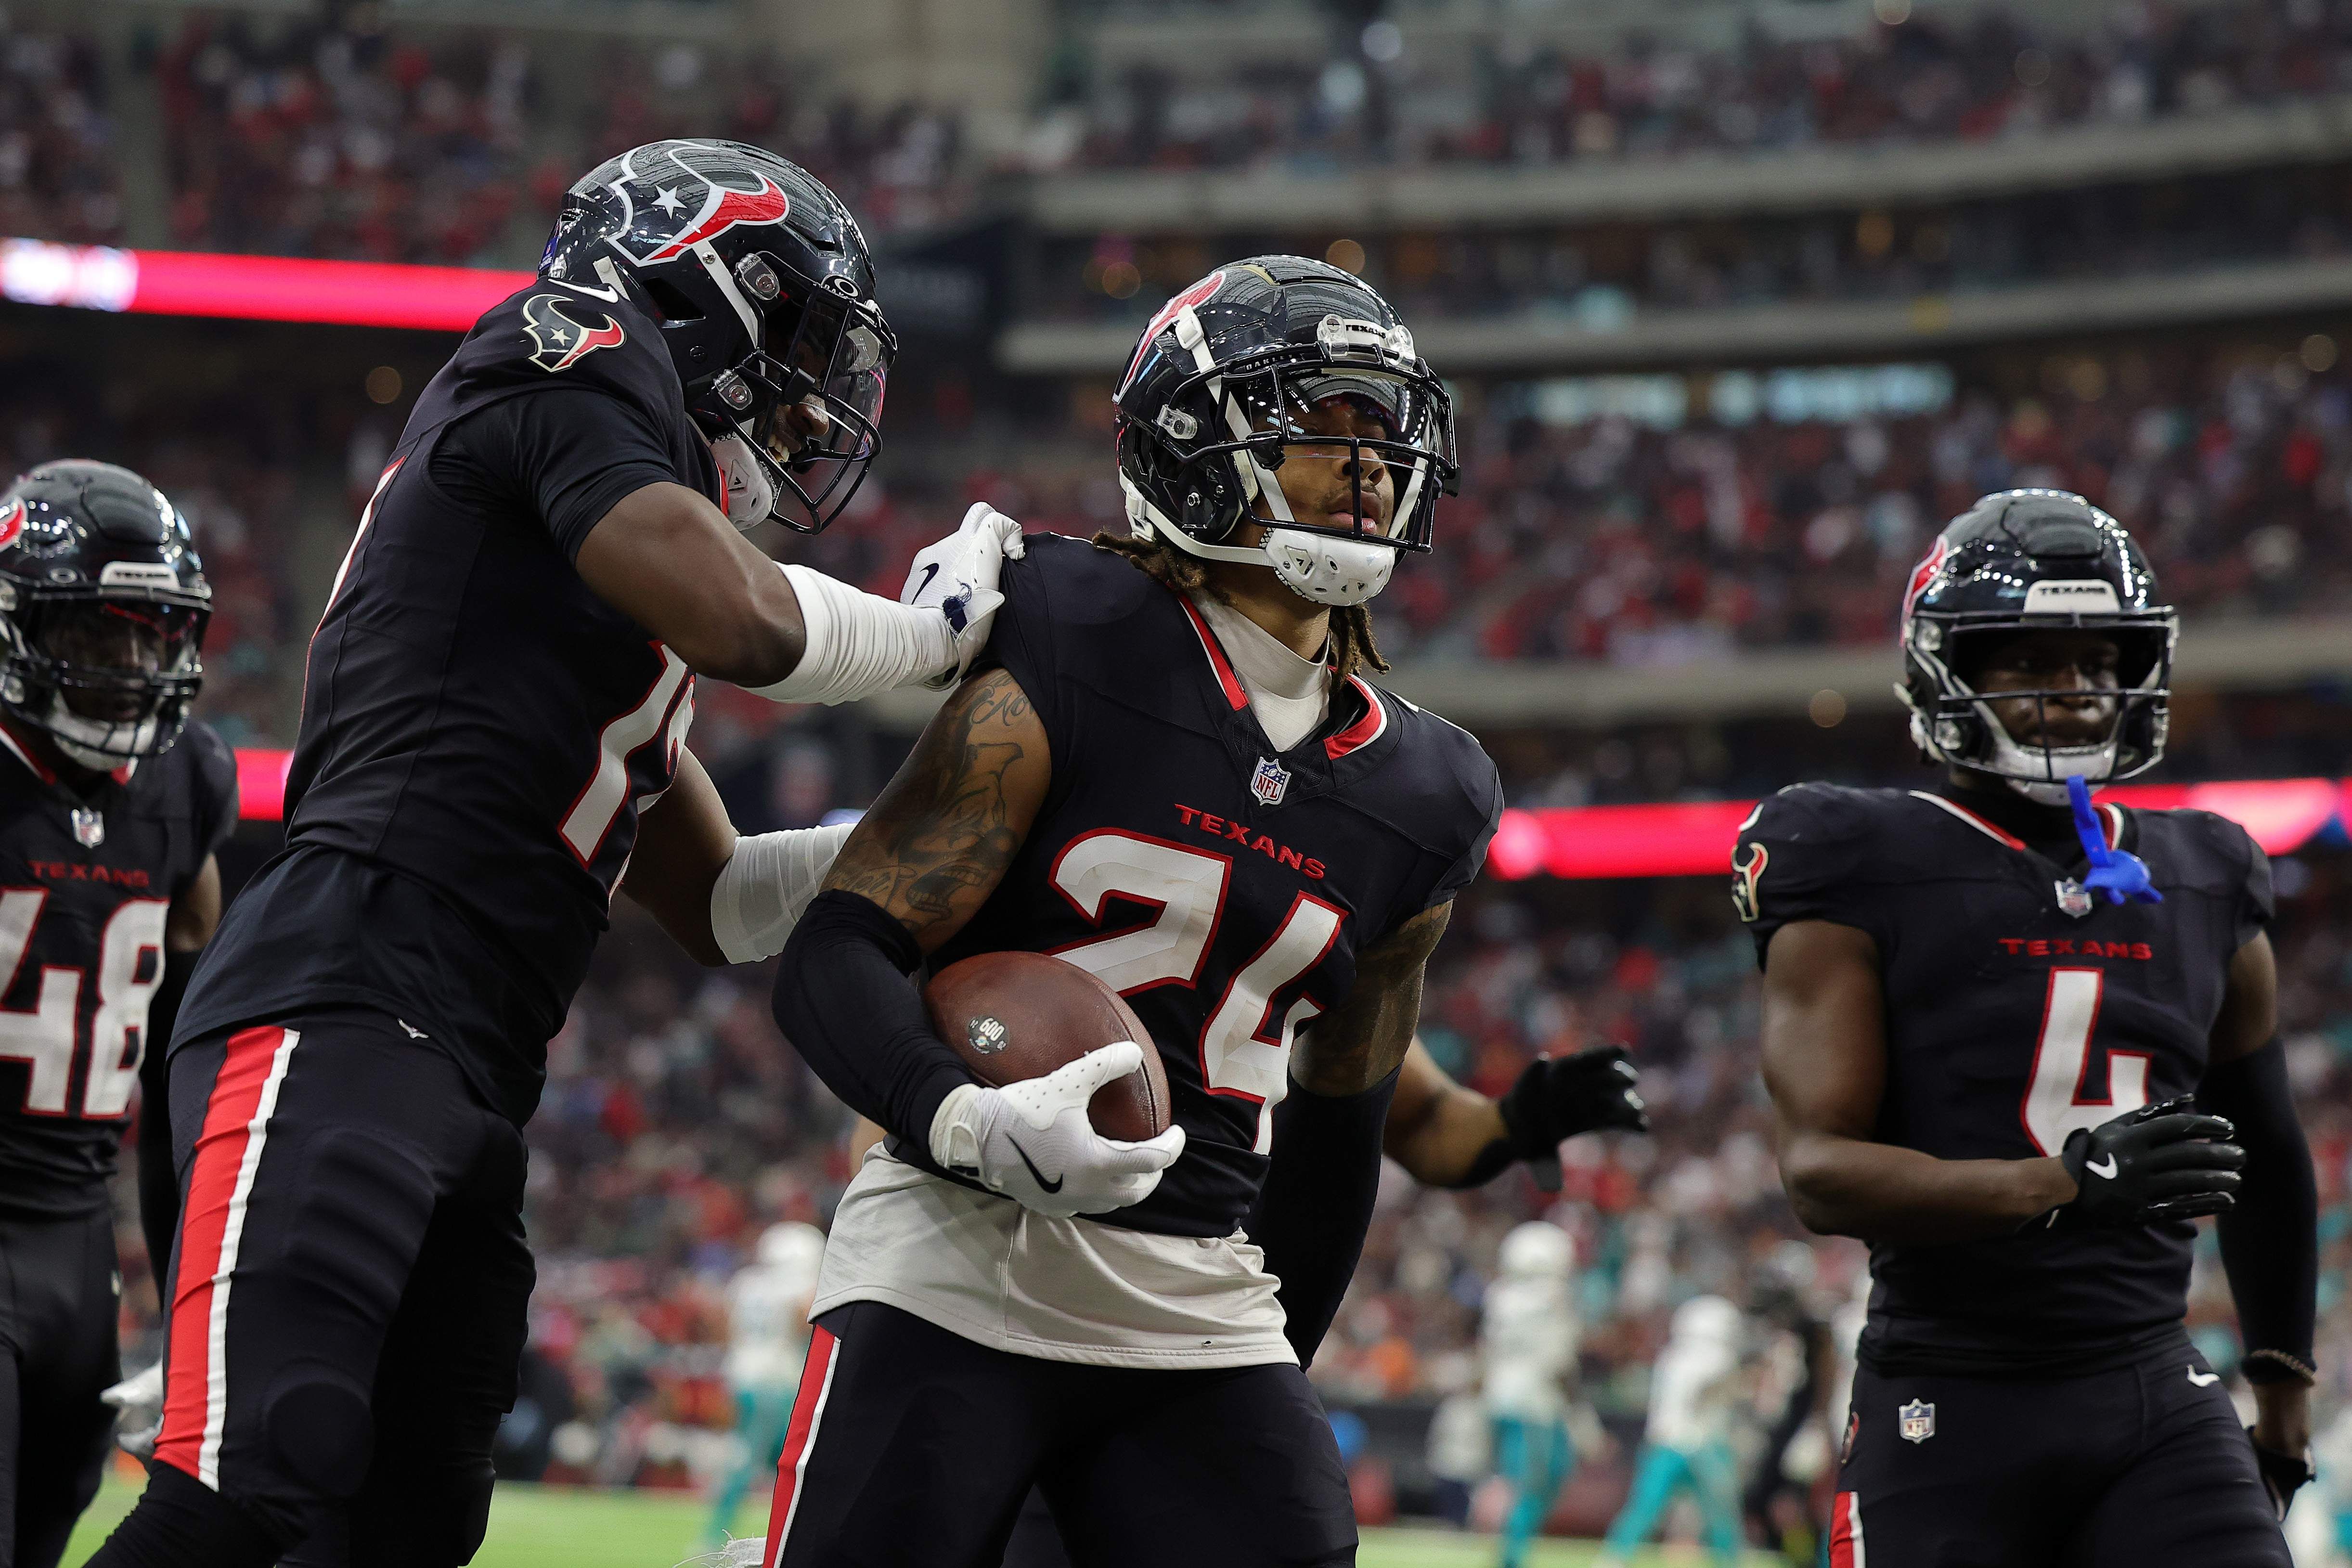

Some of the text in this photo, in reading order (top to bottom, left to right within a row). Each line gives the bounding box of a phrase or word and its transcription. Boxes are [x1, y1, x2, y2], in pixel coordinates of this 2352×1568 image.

[1256, 775, 1278, 799] NFL
[1174, 803, 1326, 880] TEXANS
[27, 859, 149, 888] TEXANS
[1998, 937, 2153, 960] TEXANS
[0, 885, 170, 1120] 48
[1043, 828, 1348, 1156] 24
[980, 1018, 1005, 1041] 600
[2020, 965, 2153, 1157] 4
